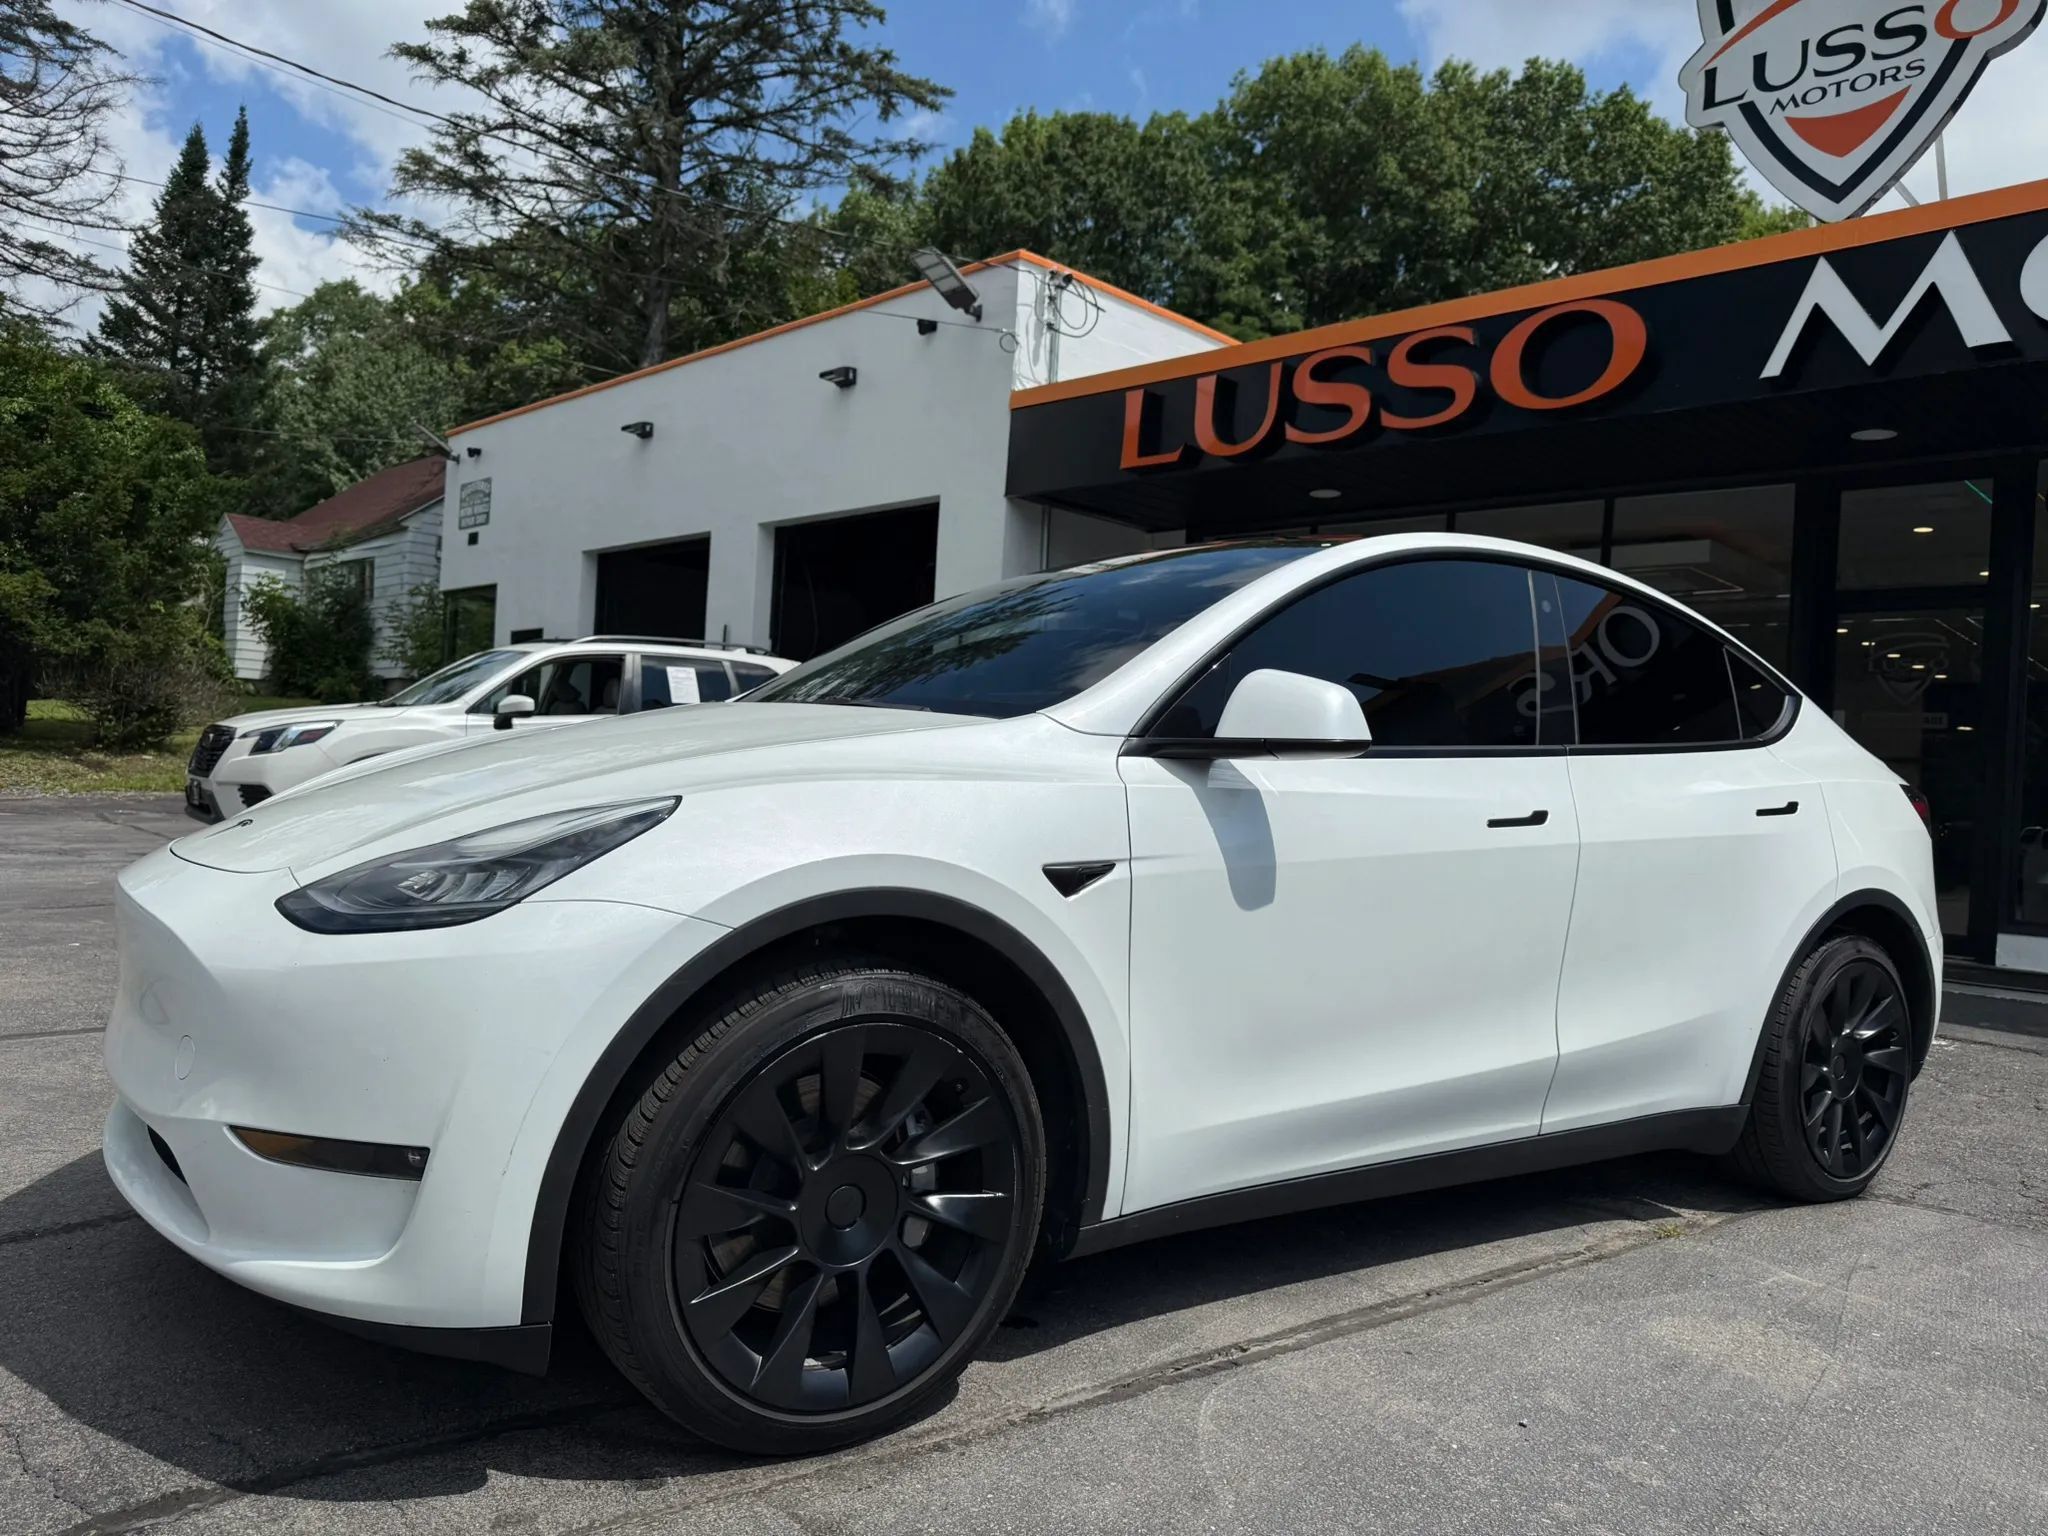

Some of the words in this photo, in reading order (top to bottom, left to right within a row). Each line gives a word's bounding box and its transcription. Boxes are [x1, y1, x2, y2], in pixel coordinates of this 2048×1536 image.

[1702, 0, 2020, 112] LUSSO
[1769, 58, 1926, 115] MOTORS
[1120, 299, 1648, 470] LUSSO
[1759, 229, 2048, 379] M
